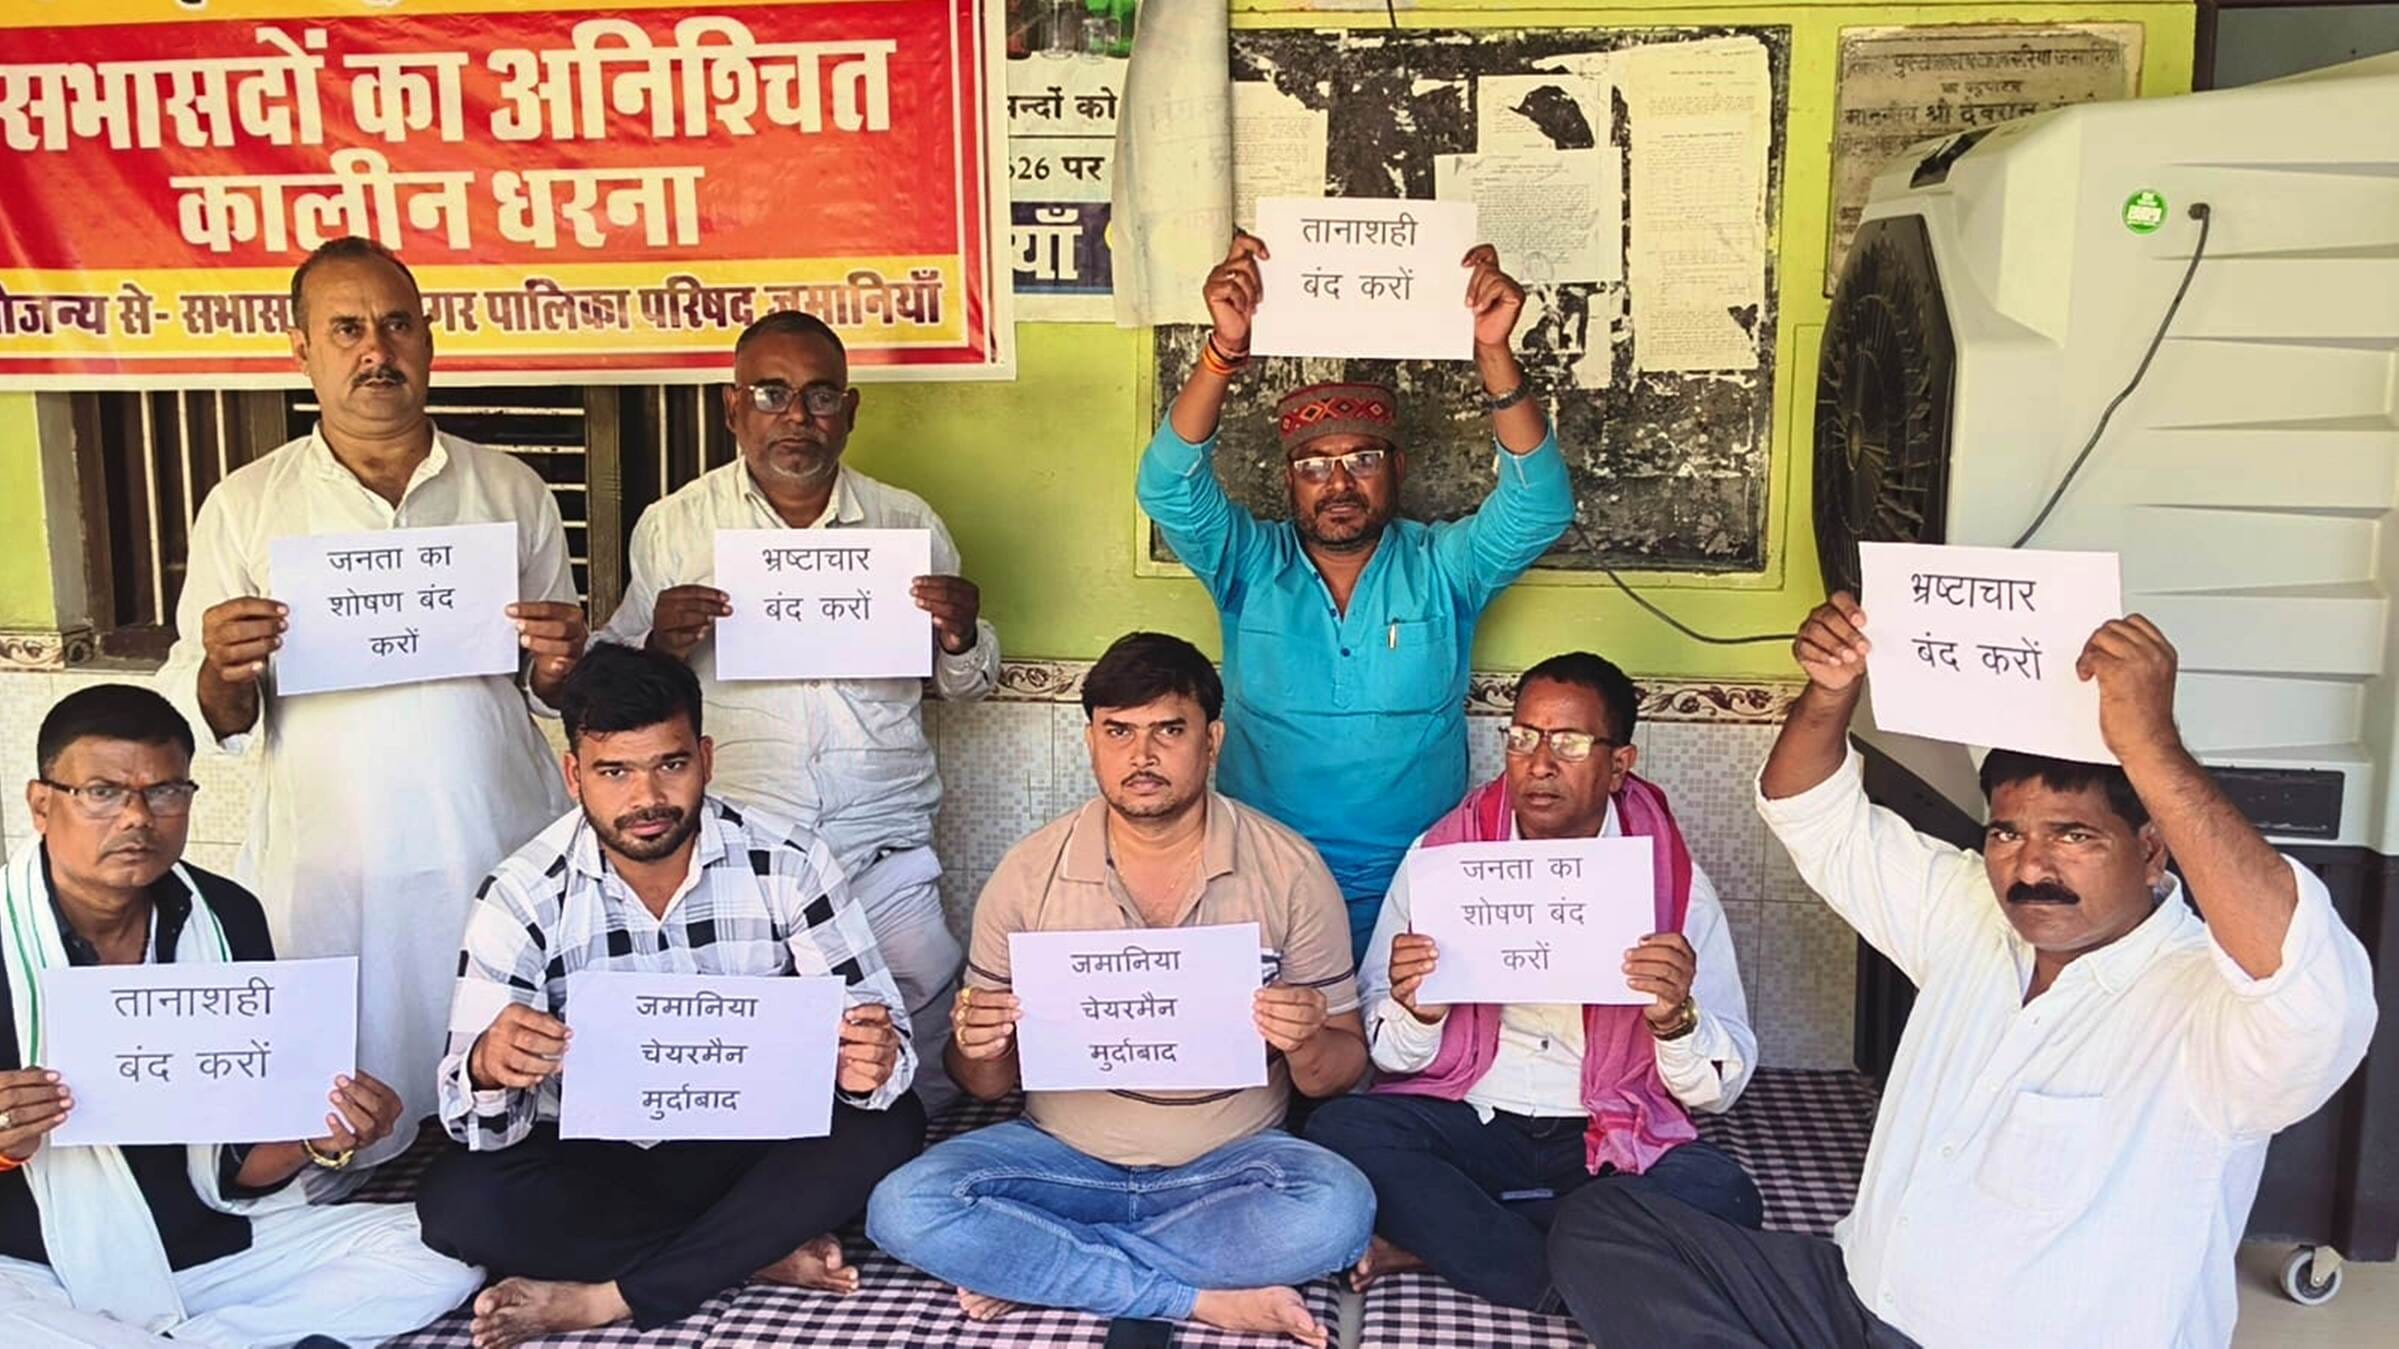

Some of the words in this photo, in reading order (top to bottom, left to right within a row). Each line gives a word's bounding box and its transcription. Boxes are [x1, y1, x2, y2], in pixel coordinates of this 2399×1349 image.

[0, 27, 327, 151] सभासदों
[343, 52, 469, 142] का
[487, 16, 897, 141] अनिश्चित
[1075, 86, 1118, 119] को
[1062, 157, 1104, 181] पर
[170, 148, 474, 252] कालीन
[492, 166, 704, 249] धरना
[1301, 212, 1418, 247] तानाशही
[1302, 267, 1343, 299] बंद
[1359, 267, 1413, 300] करों
[421, 292, 478, 332] गर
[484, 279, 631, 331] पालिका
[638, 275, 756, 328] परिषद
[327, 549, 403, 571] जनता
[418, 546, 452, 567] का
[763, 548, 870, 571] भ्रष्टाचार
[328, 588, 404, 616] शोषण
[418, 584, 455, 609] बंद
[764, 592, 803, 621] बंद
[819, 589, 871, 620] करों
[1911, 574, 2036, 611] भ्रष्टाचार
[370, 628, 419, 656] करों
[1912, 632, 1960, 671] बंद
[1976, 637, 2042, 680] करों
[1461, 860, 1533, 880] जनता
[1548, 858, 1582, 878] का
[1462, 898, 1533, 925] शोषण
[1549, 897, 1584, 924] बंद
[1071, 946, 1181, 973] जमानिया
[1502, 942, 1549, 969] करों
[111, 978, 275, 1016] तानाशही
[636, 991, 758, 1017] जमानिया
[1081, 992, 1177, 1019] चेयरमैन
[116, 1046, 173, 1082] बंद
[196, 1040, 271, 1079] करों
[641, 1038, 748, 1064] चेयरमैन
[1089, 1038, 1177, 1071] मुर्दाबाद
[643, 1084, 740, 1120] मुर्दाबाद
